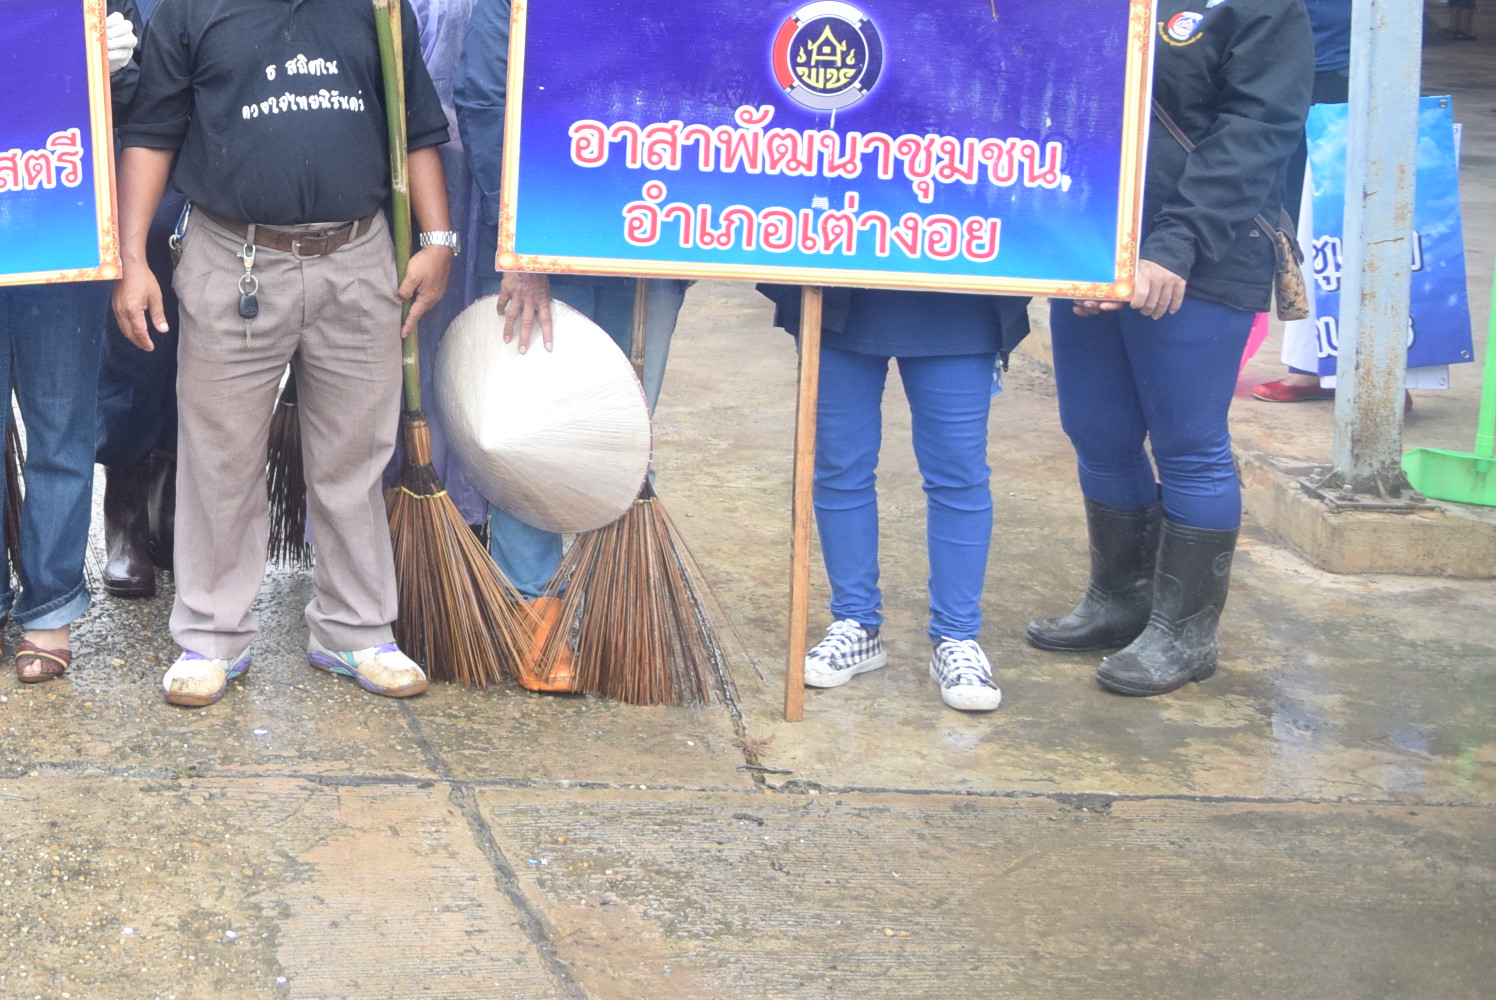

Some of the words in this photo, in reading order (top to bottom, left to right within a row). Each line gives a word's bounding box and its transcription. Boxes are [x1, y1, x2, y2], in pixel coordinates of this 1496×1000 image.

[285, 53, 338, 76] สถิตใน
[570, 106, 1064, 201] อาสาพัฒนาชุมชน
[625, 181, 1000, 260] อำเภอเต่างอย
